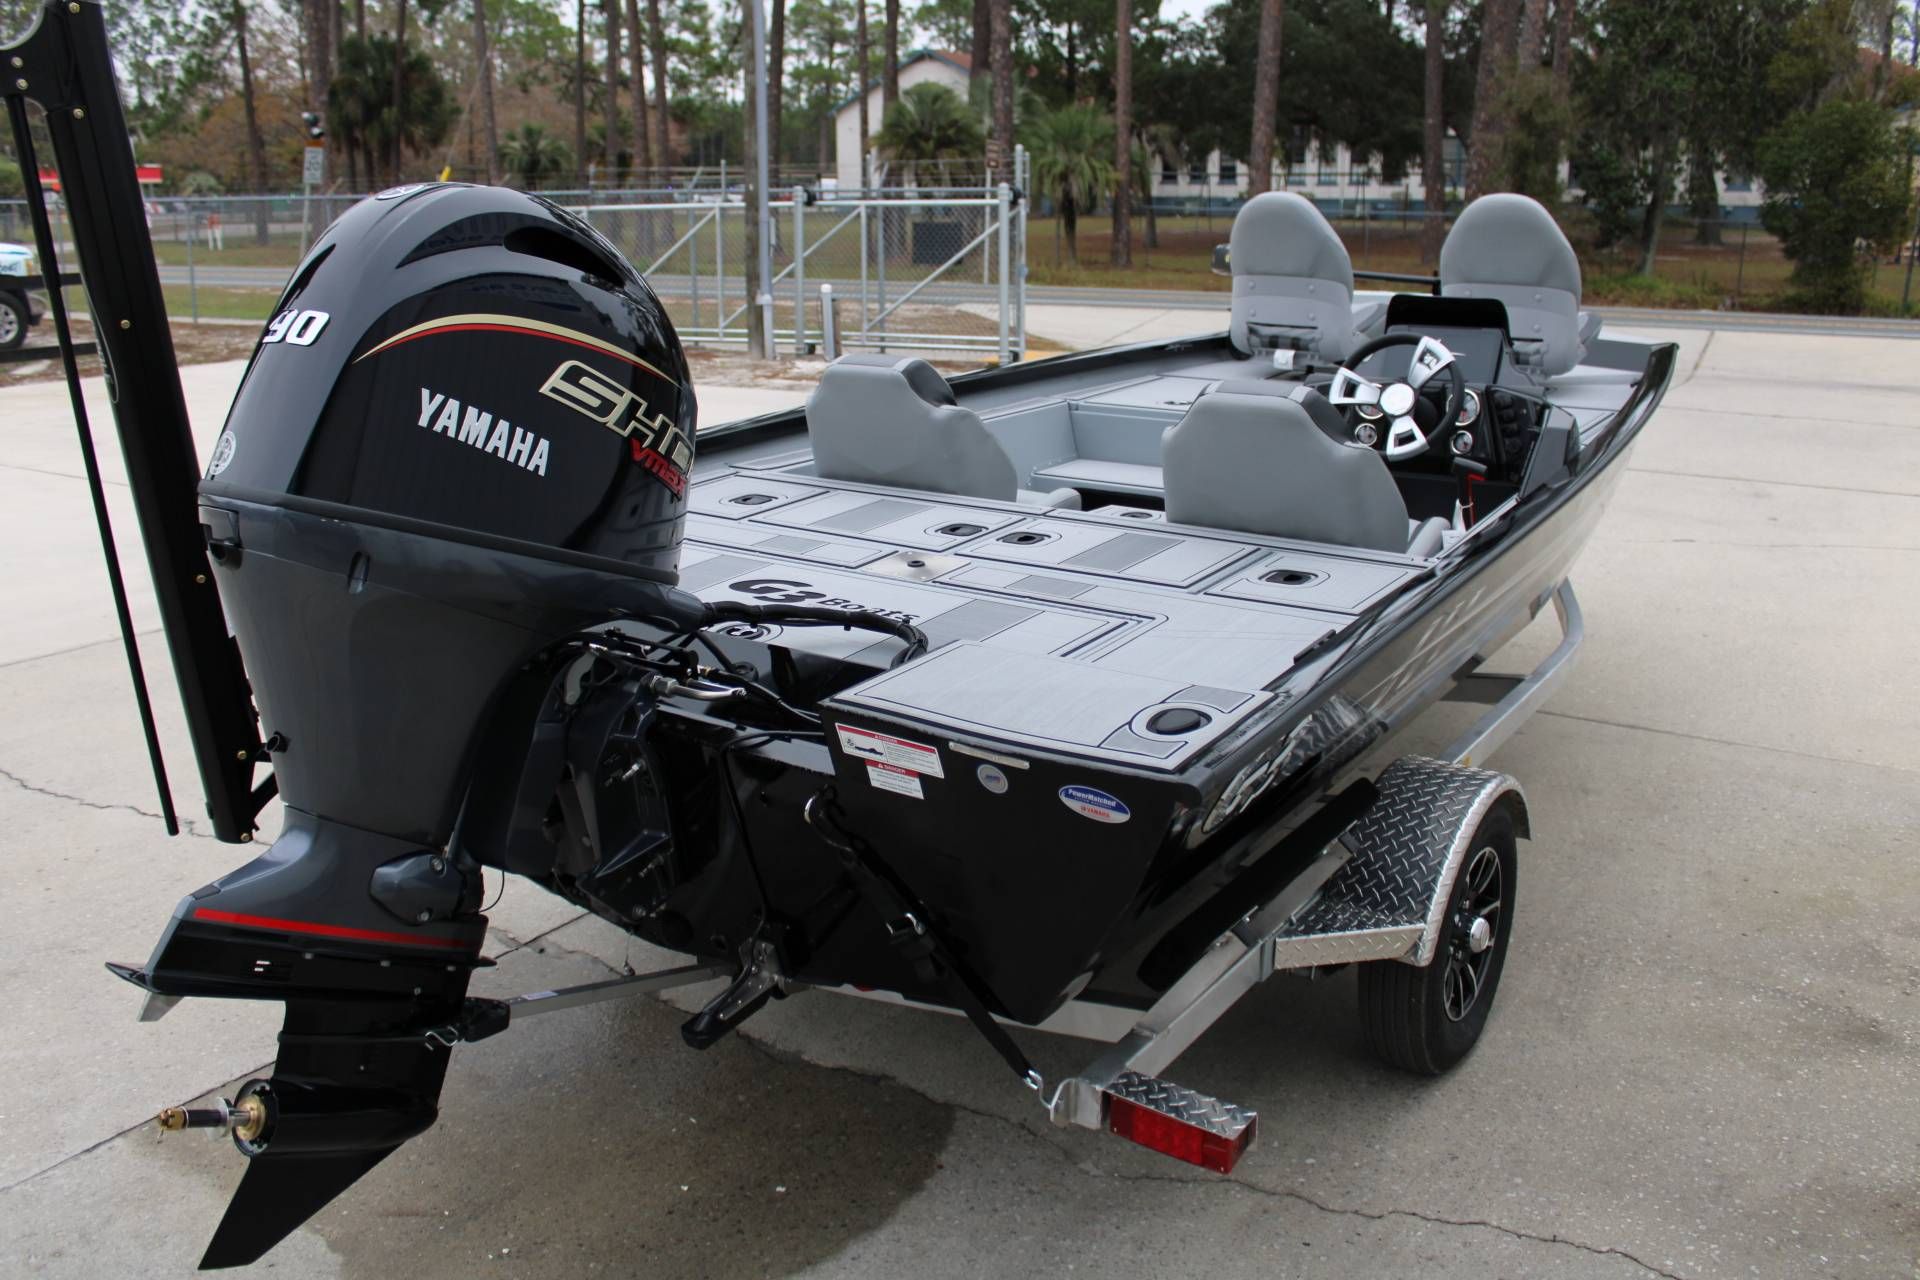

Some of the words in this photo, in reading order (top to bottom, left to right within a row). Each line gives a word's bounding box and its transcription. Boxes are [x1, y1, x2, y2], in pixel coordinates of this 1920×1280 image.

[262, 309, 330, 346] 90
[418, 387, 551, 477] YAMAHA
[538, 360, 695, 480] SHO
[728, 579, 827, 603] G3
